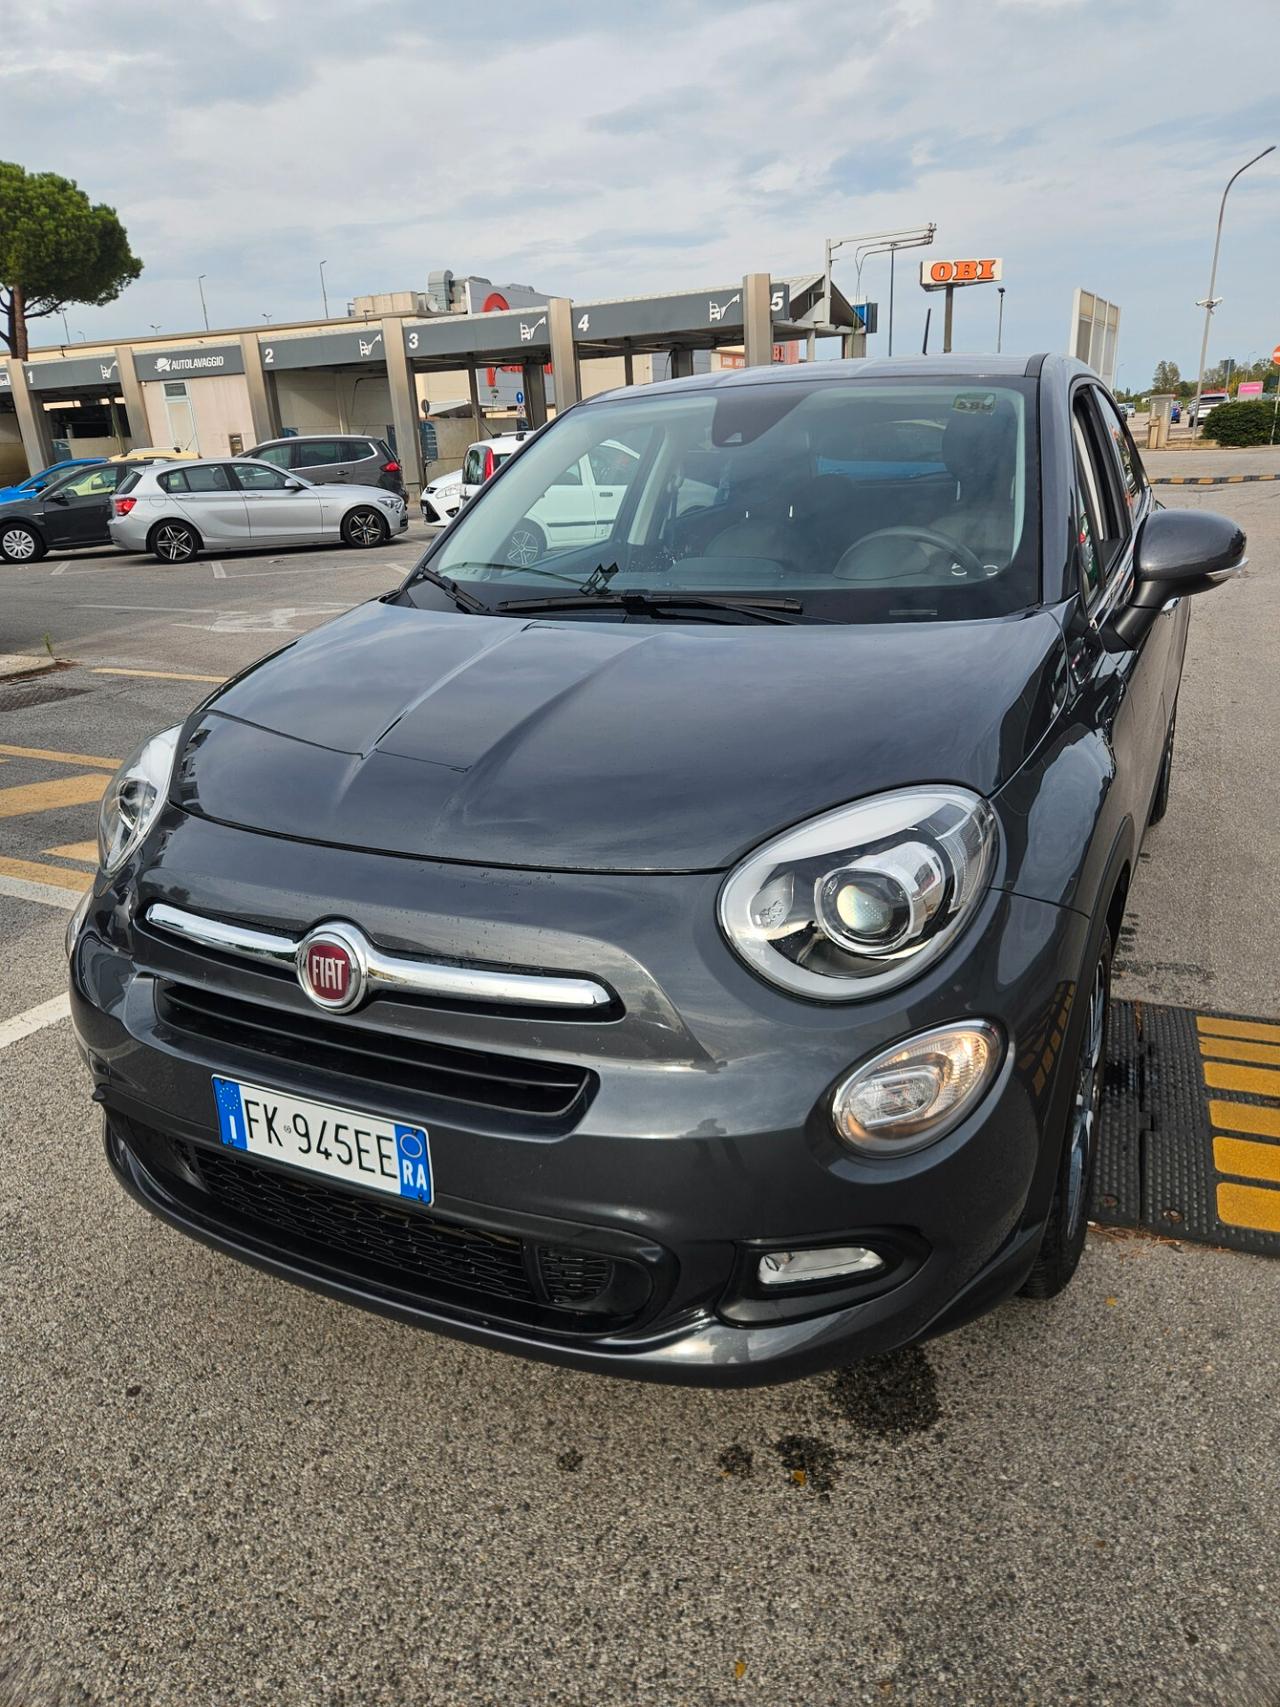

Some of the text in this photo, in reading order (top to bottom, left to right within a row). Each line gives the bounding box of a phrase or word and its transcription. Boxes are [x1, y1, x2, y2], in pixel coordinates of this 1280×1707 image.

[930, 259, 997, 281] OBI
[770, 291, 784, 311] 5
[578, 313, 590, 332] 4
[408, 332, 419, 350] 3
[264, 348, 274, 364] 2
[772, 344, 785, 361] BI
[171, 355, 224, 370] AUTOLAVAGGIO
[27, 370, 34, 384] 1
[311, 955, 346, 991] FIAT
[229, 1116, 237, 1140] I
[403, 1159, 427, 1190] RA
